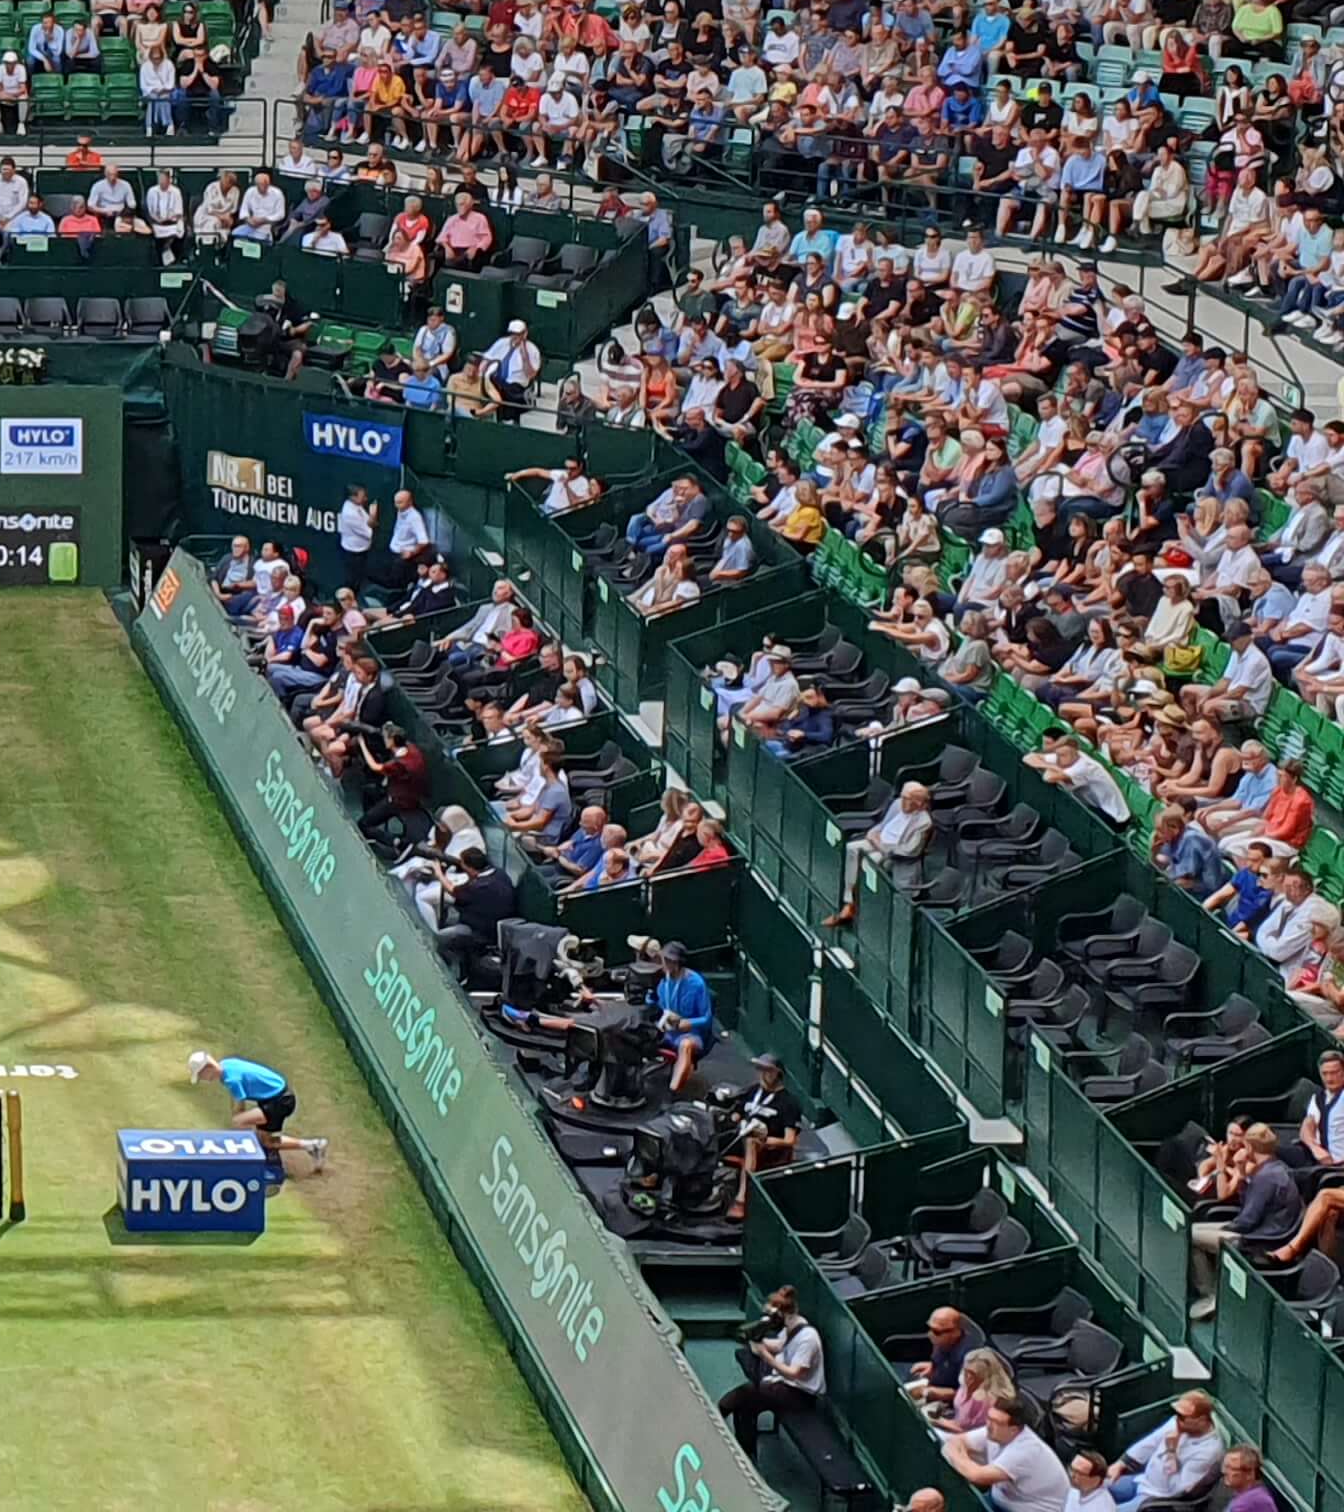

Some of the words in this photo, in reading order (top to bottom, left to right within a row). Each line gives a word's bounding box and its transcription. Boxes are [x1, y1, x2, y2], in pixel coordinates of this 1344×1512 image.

[4, 452, 34, 466] 217
[39, 452, 78, 466] km/h
[212, 488, 299, 525] TROCKENEN
[213, 454, 246, 488] NR.
[252, 463, 262, 491] 1
[267, 474, 293, 498] BEI
[173, 605, 238, 725] Samsonite
[256, 749, 336, 897] Samsonite
[363, 934, 464, 1117] Samsonite
[479, 1134, 606, 1364] Samsonite
